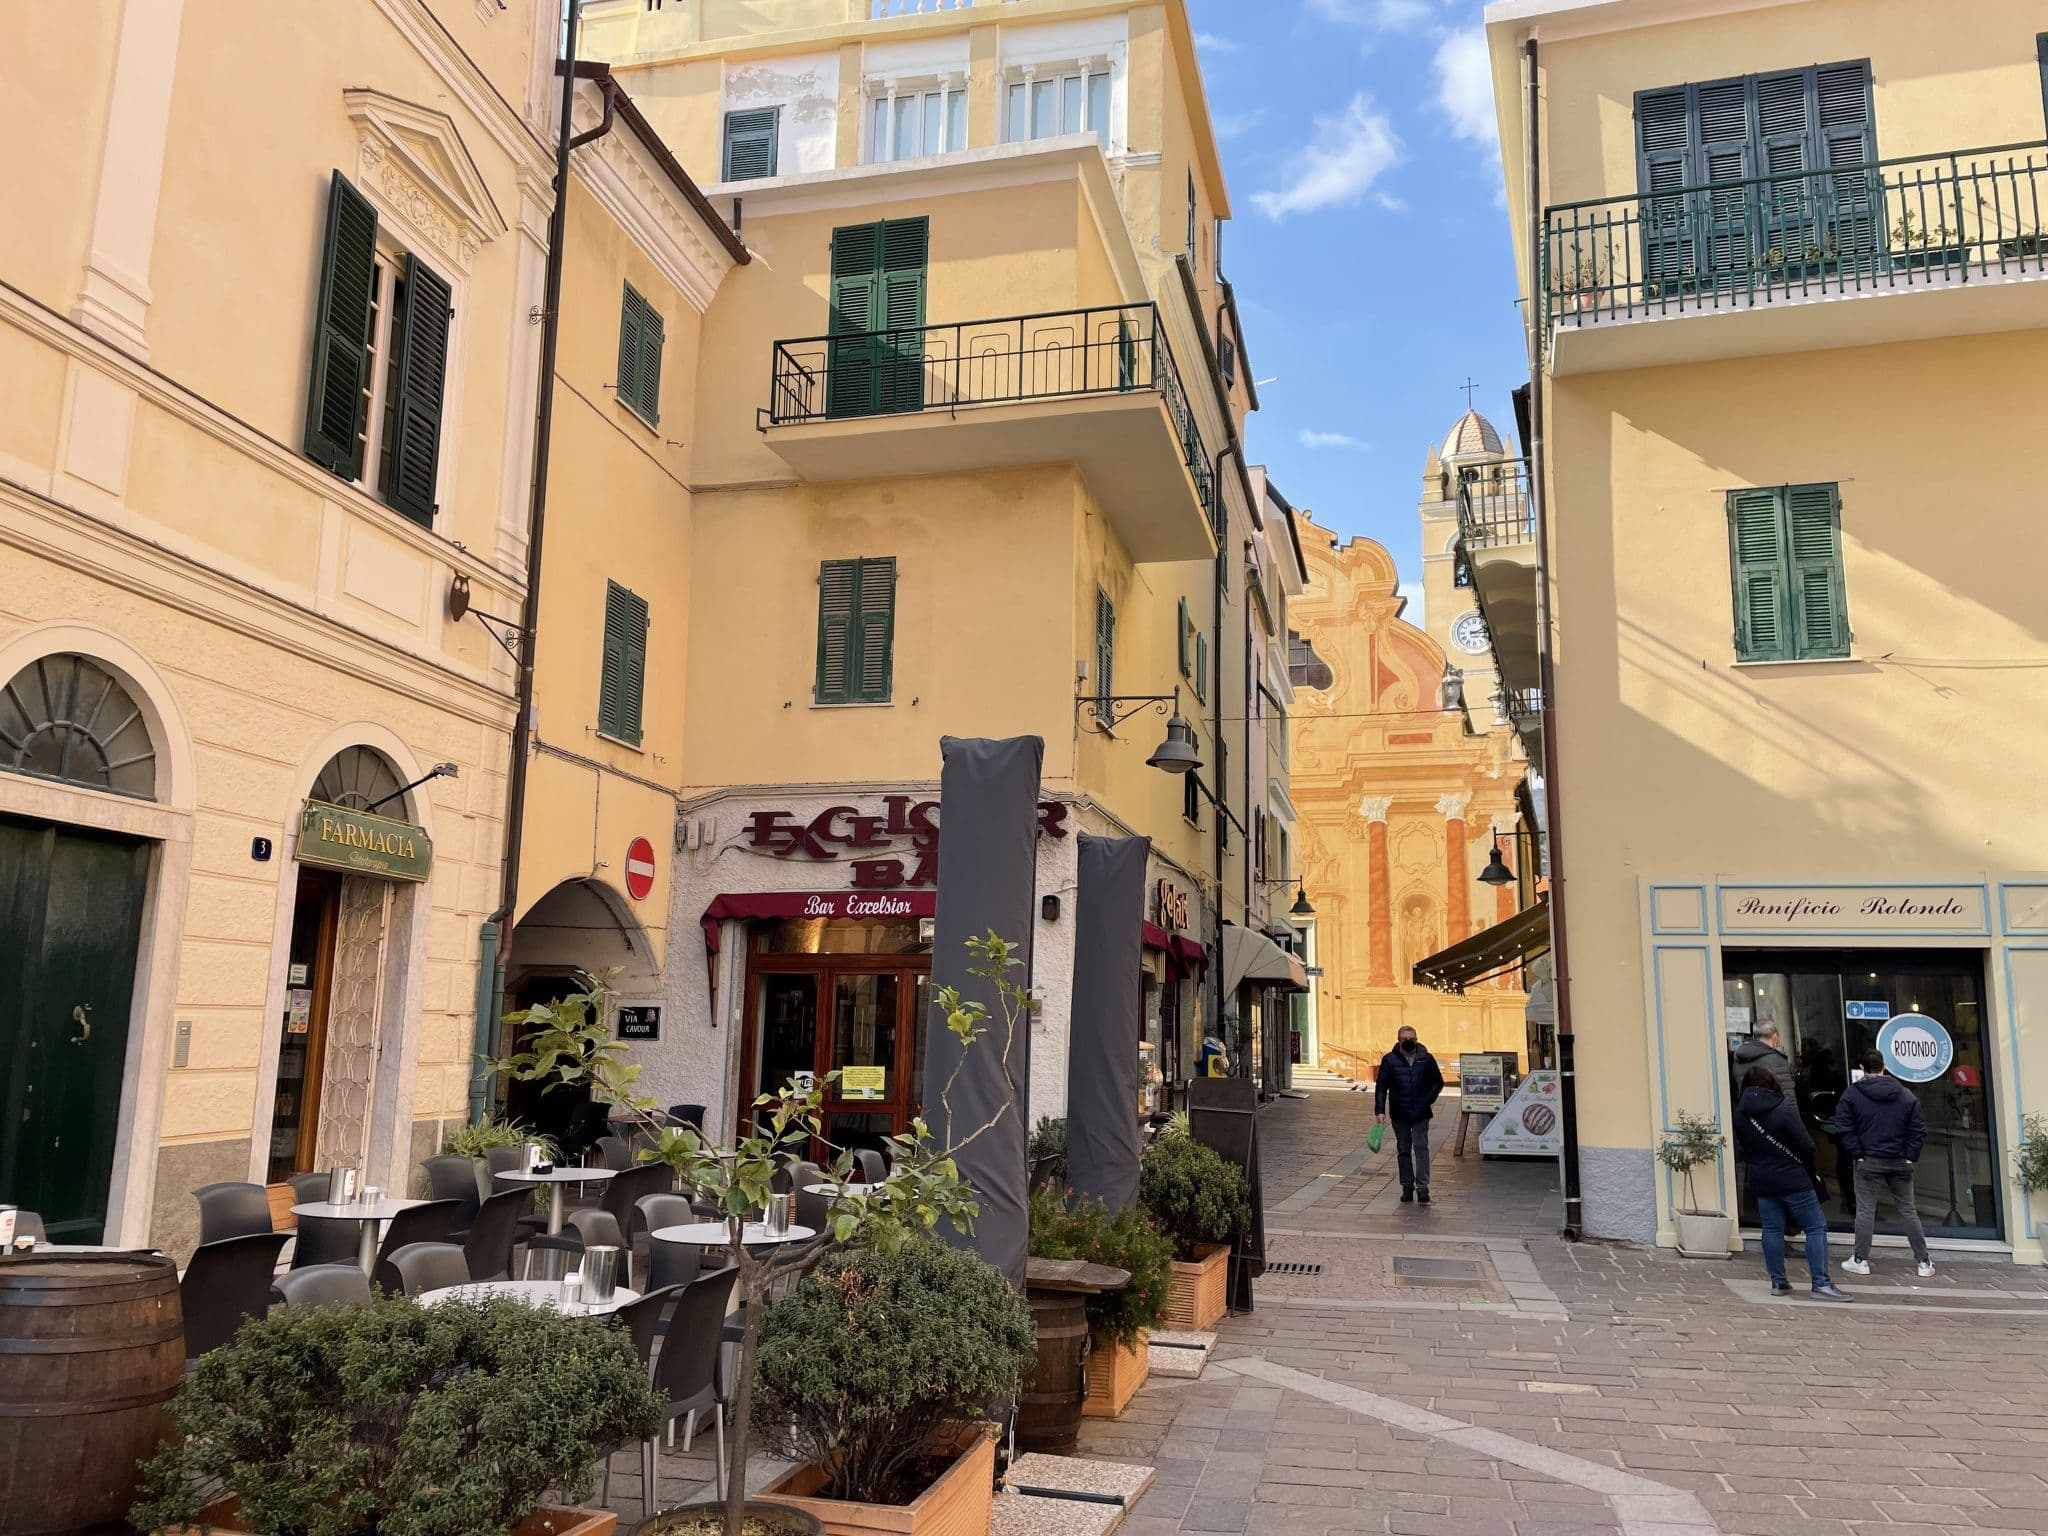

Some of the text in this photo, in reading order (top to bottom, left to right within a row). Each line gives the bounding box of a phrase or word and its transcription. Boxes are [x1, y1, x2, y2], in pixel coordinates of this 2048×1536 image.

[741, 795, 1069, 859] EXCELSR
[260, 841, 267, 854] 3
[320, 818, 415, 859] FARMACIA
[850, 851, 939, 888] BA
[804, 894, 912, 915] Bar Excelsior
[1736, 896, 1966, 922] Panificio Rotondo
[625, 1014, 638, 1023] VIA
[625, 1025, 650, 1033] CAVOUR
[1894, 1040, 1937, 1058] ROTONDO
